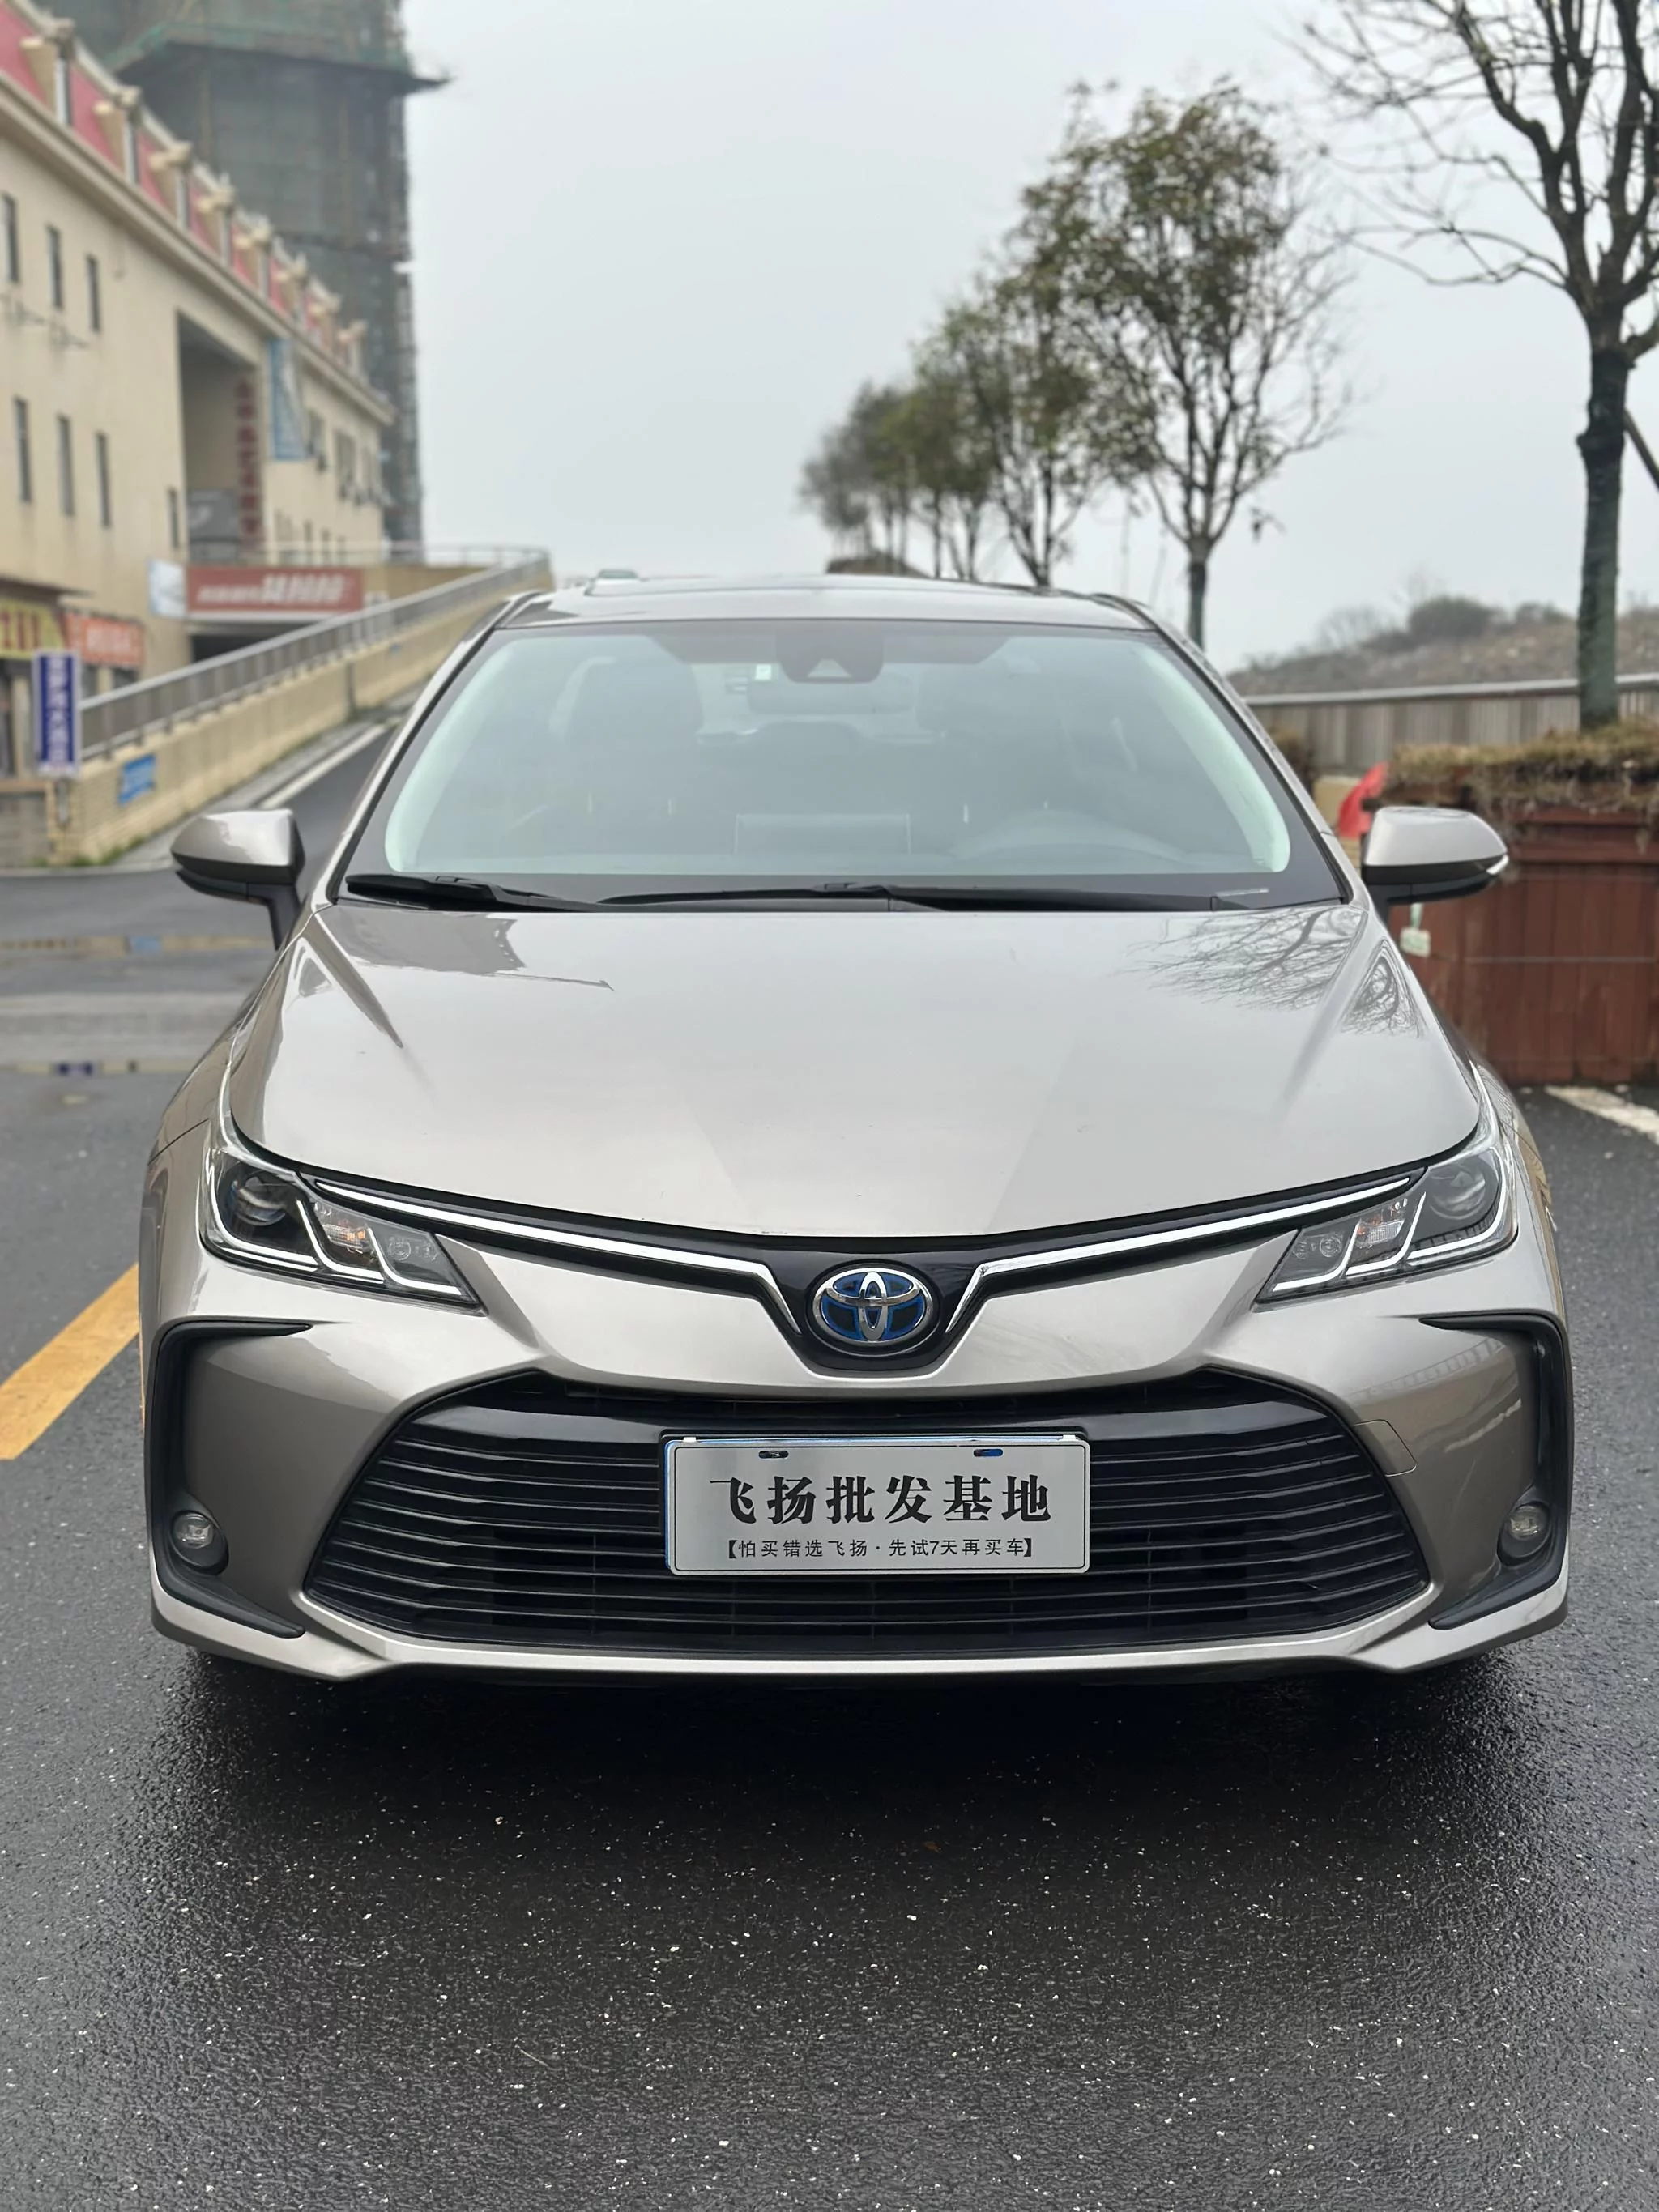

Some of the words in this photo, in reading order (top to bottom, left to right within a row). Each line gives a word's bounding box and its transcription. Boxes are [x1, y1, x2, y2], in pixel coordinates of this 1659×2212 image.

[709, 1474, 1051, 1524] 飞扬批发基地
